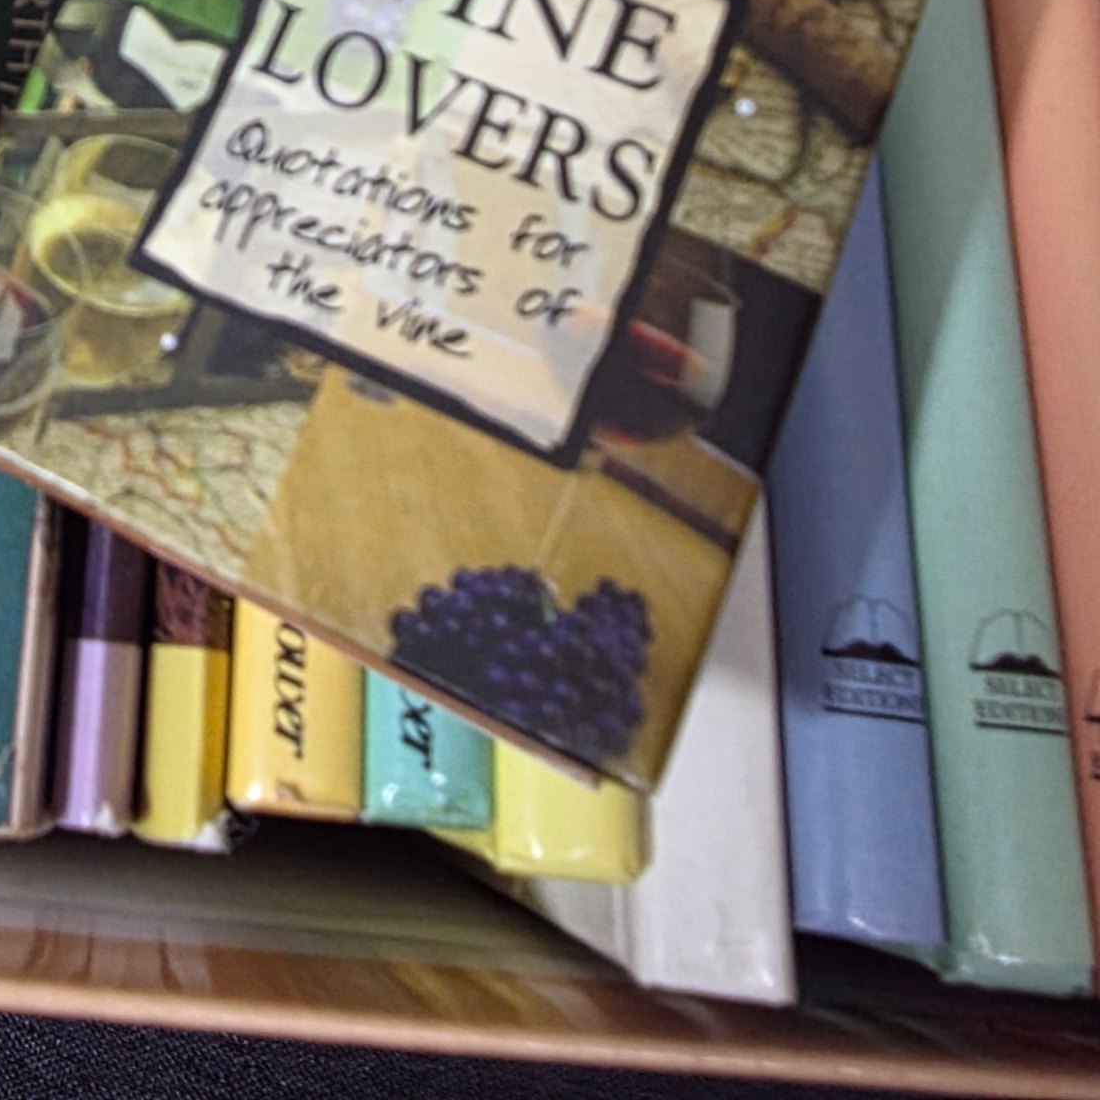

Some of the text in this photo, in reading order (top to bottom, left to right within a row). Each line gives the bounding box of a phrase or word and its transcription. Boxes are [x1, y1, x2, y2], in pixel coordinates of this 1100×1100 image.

[198, 177, 584, 326] appreciators of
[225, 117, 588, 268] Quotations for
[265, 255, 343, 314] the
